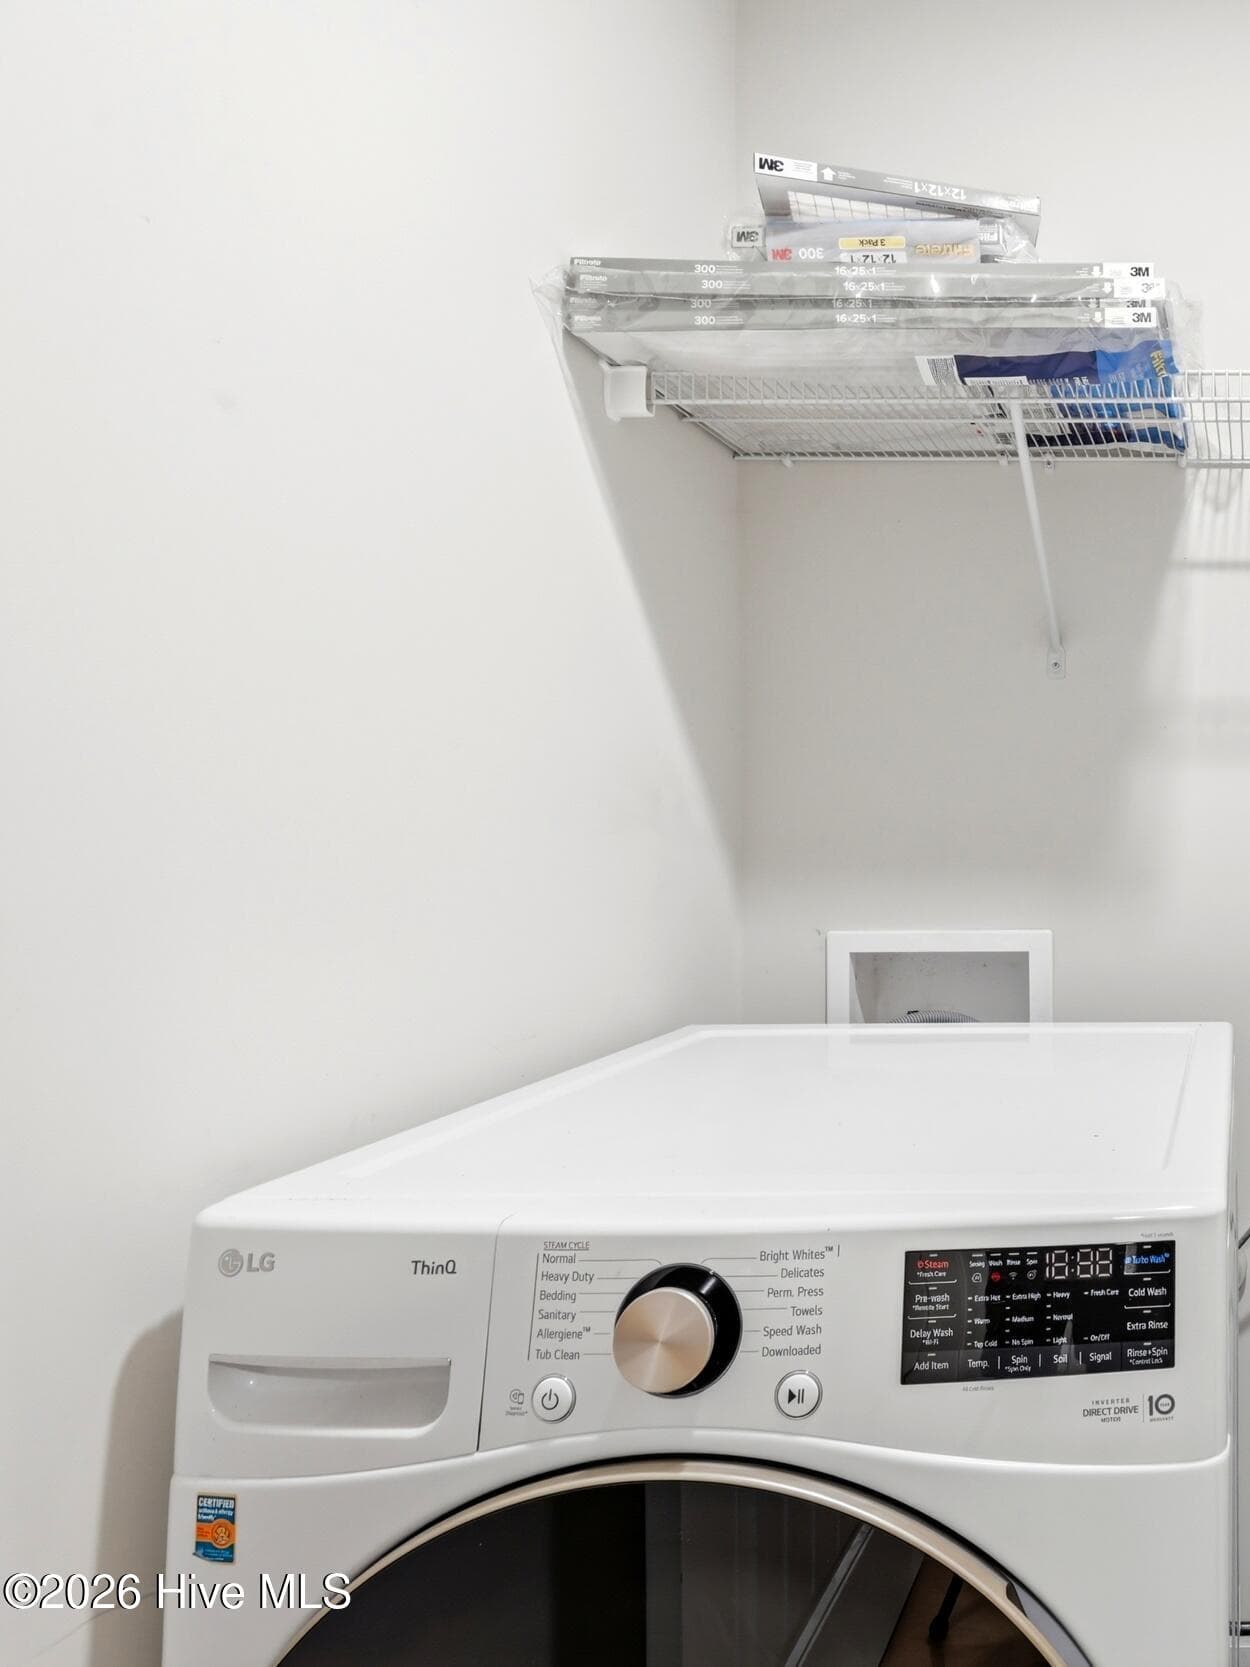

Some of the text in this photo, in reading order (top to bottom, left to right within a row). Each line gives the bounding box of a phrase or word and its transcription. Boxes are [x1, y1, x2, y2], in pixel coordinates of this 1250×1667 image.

[758, 157, 784, 172] 3M
[858, 239, 879, 247] Pack
[772, 248, 792, 260] 3M
[798, 248, 824, 260] 300
[694, 264, 716, 274] 300
[1130, 266, 1150, 277] 3M
[701, 280, 723, 289] 300
[694, 316, 716, 325] 300
[1132, 312, 1152, 322] 3M
[543, 1242, 590, 1250] STEAM CYCLE
[246, 1252, 276, 1272] LG
[542, 1254, 576, 1264] Normal
[760, 1250, 790, 1263] Bright
[1026, 1258, 1038, 1266] Spin
[411, 1260, 457, 1275] ThinQ
[924, 1260, 949, 1270] Steam
[541, 1272, 594, 1284] Heavy Duty
[780, 1267, 825, 1279] Delicates
[540, 1290, 576, 1303] Bedding
[766, 1286, 824, 1298] Perm. Press
[1052, 1292, 1070, 1300] Heavy
[1106, 1288, 1120, 1296] Care
[1128, 1287, 1167, 1297] Cold Wash
[915, 1293, 950, 1303] Pre-wash
[538, 1308, 576, 1322] Sanitary
[790, 1306, 823, 1316] Towels
[763, 1324, 822, 1338] Speed Wash
[1126, 1320, 1168, 1331] Extra Rinse
[910, 1328, 954, 1339] Delay Wash
[1022, 1338, 1034, 1346] Spin
[1052, 1336, 1068, 1344] Light
[536, 1350, 580, 1360] Tub Clean
[762, 1344, 822, 1358] Downloaded
[1011, 1354, 1028, 1366] Spin
[1054, 1354, 1068, 1364] Soil
[1090, 1352, 1112, 1364] Signal
[914, 1360, 950, 1370] Add Item
[968, 1359, 990, 1369] Temp.
[1148, 1394, 1175, 1416] 10
[1082, 1405, 1138, 1418] DIRECT DRIVE
[198, 1498, 234, 1509] CERTIFIED
